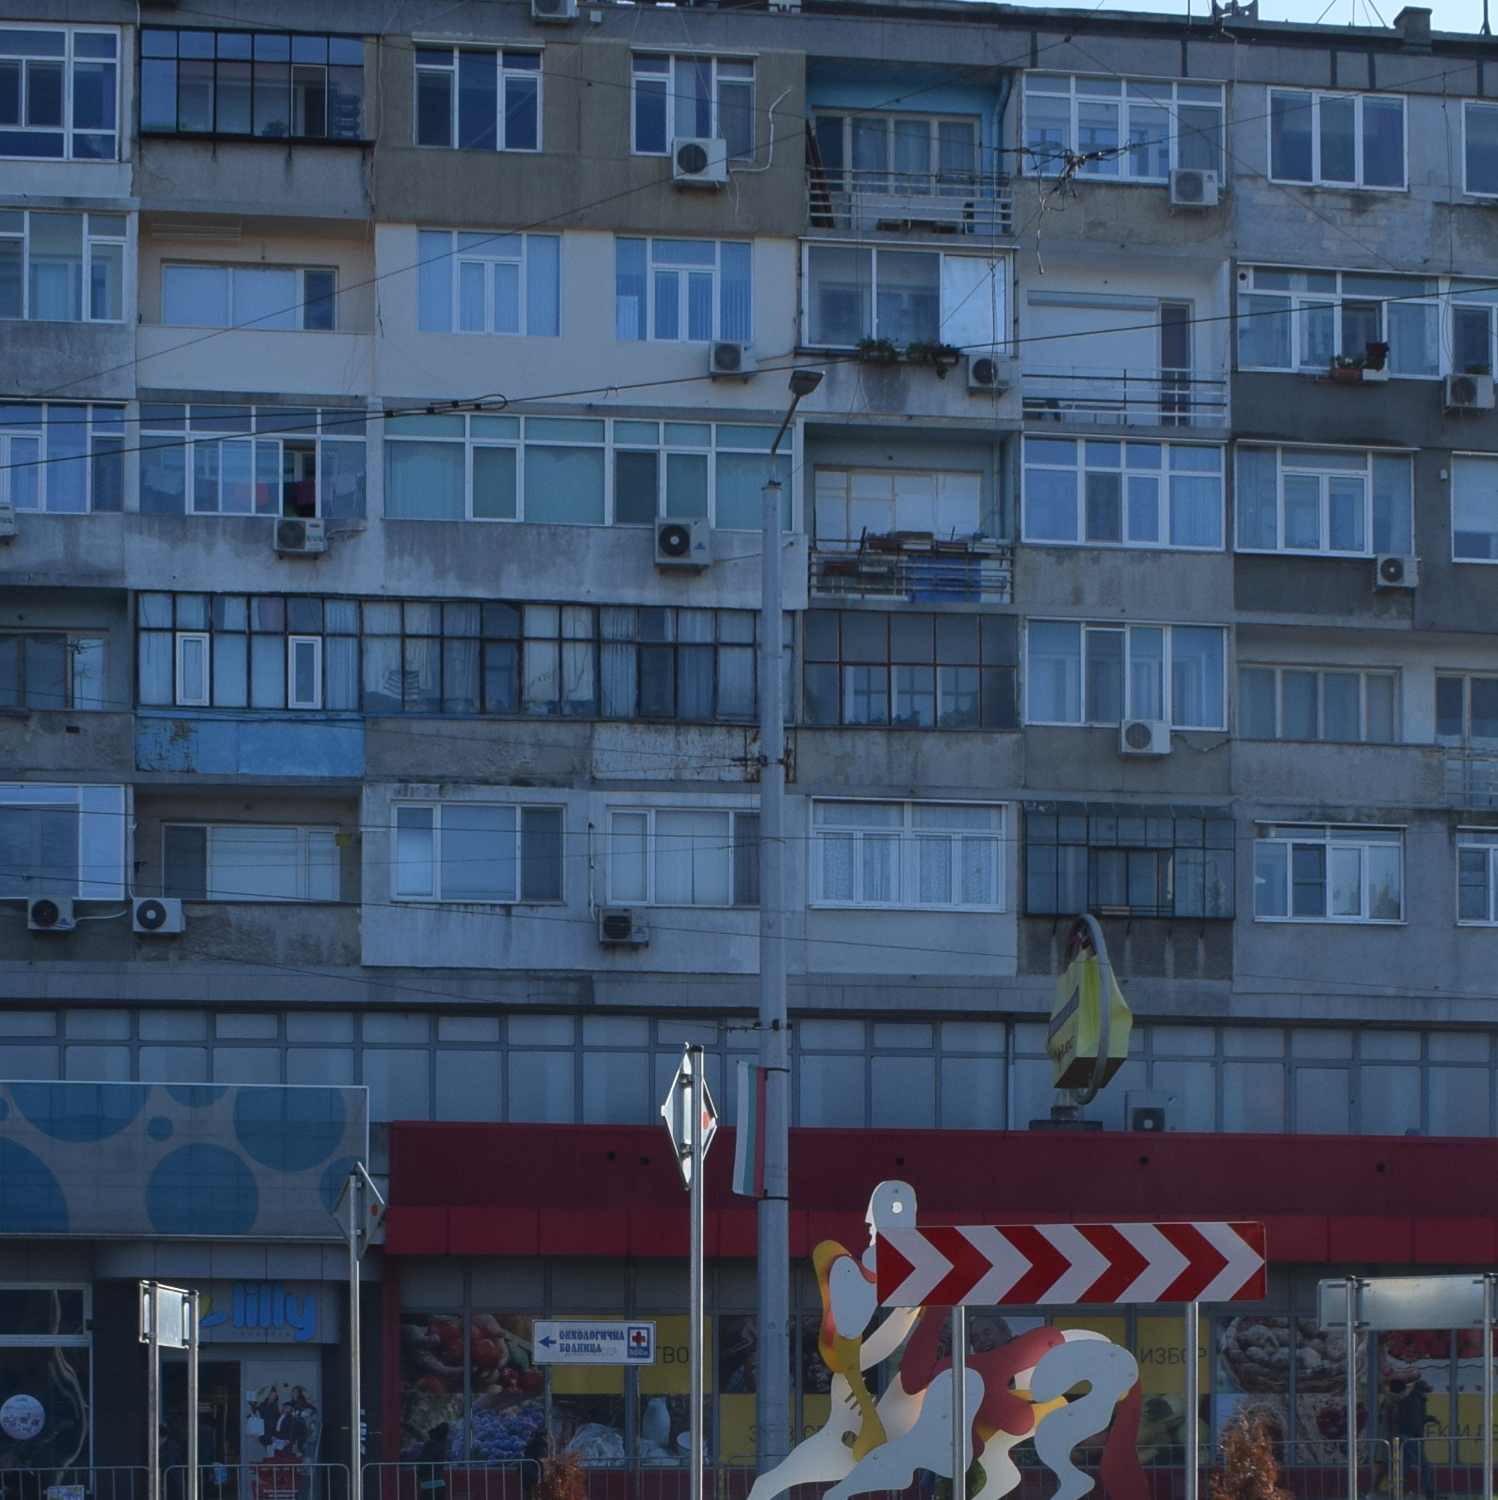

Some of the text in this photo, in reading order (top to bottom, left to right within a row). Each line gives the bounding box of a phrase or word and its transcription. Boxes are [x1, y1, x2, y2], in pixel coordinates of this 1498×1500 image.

[233, 1281, 316, 1341] lilly
[559, 1331, 625, 1341] ОНКОЛОГИЧНА
[559, 1343, 602, 1354] БОЛНИЦА
